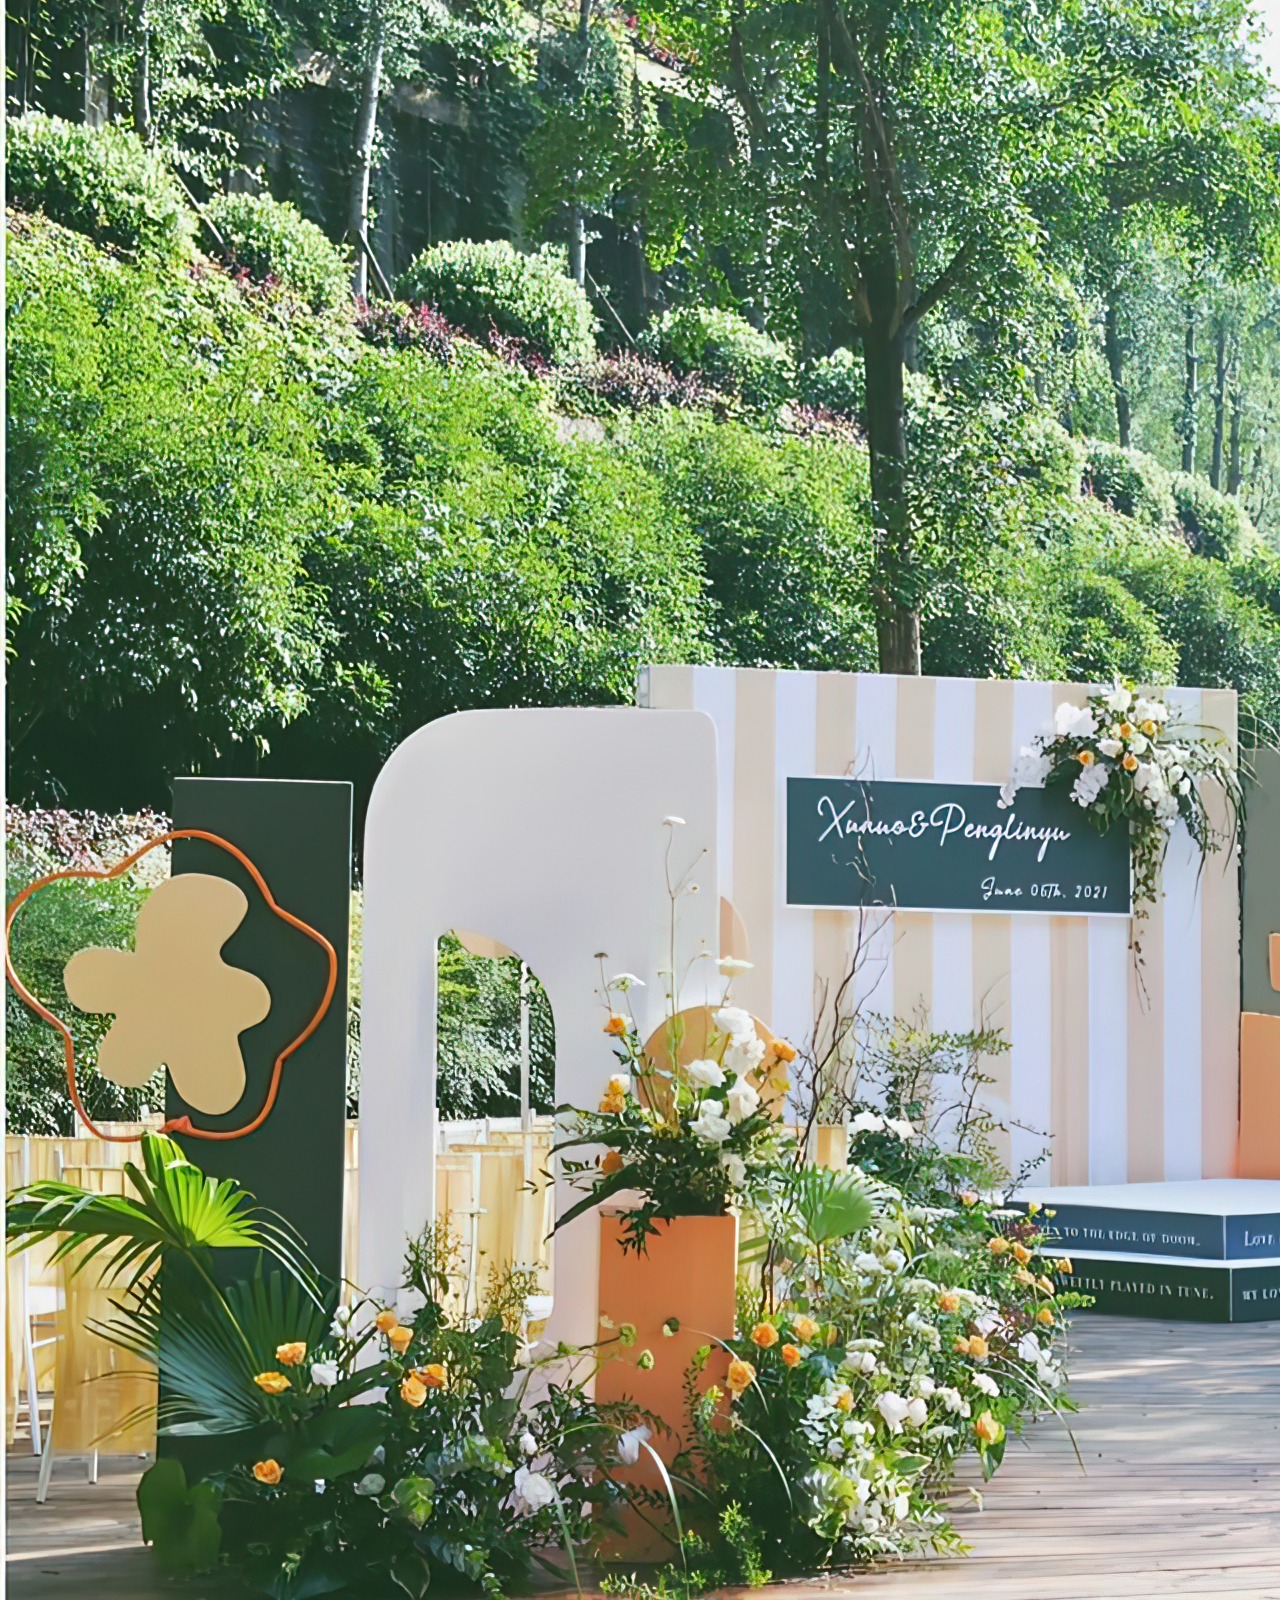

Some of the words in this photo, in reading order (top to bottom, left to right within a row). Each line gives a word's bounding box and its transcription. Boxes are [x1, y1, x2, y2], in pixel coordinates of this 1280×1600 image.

[980, 876, 1023, 901] June
[1074, 884, 1108, 899] 2021
[1063, 1226, 1079, 1238] TO
[1083, 1227, 1106, 1240] THE
[1110, 1281, 1155, 1295] PLAYED
[1159, 1285, 1173, 1296] IN
